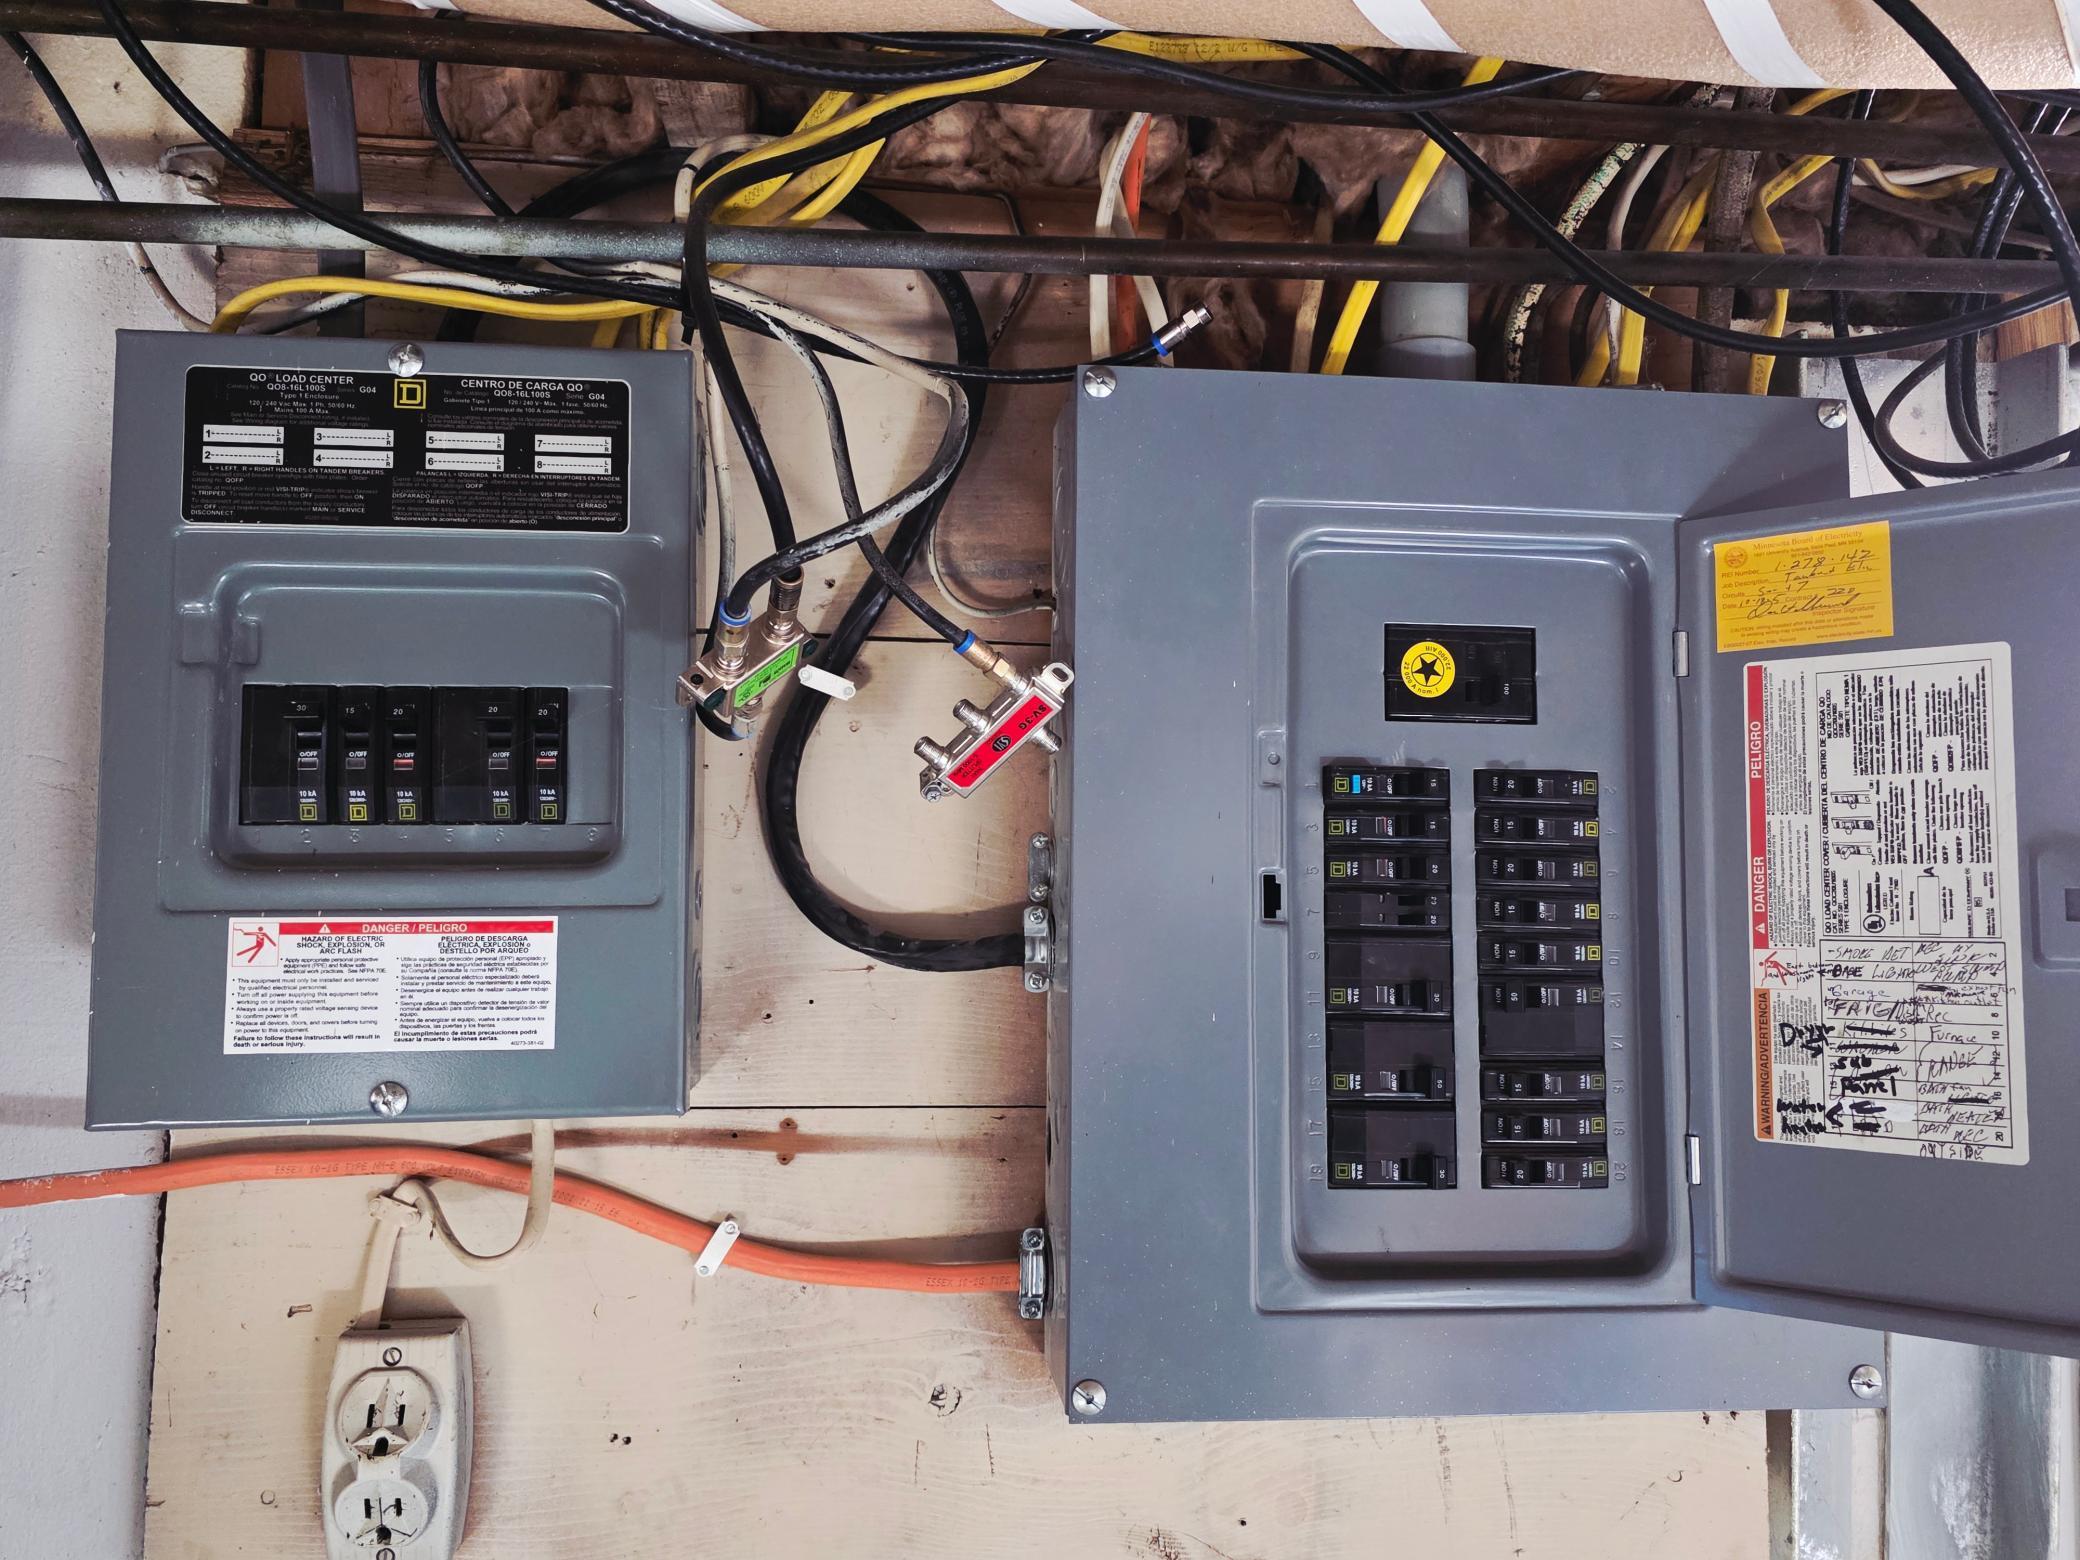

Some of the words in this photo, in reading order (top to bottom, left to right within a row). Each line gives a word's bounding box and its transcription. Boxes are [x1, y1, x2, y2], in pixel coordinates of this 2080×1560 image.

[250, 373, 266, 382] QO
[276, 374, 306, 383] LOAD
[310, 375, 354, 385] CENTER
[267, 383, 326, 392] QO8-16L100S
[360, 386, 376, 394] G04
[461, 380, 506, 389] CENTRO
[508, 381, 523, 389] DE
[526, 382, 564, 391] CARGA
[567, 383, 583, 392] QO
[589, 393, 605, 401] G04
[206, 430, 211, 438] 1
[316, 433, 323, 441] 3
[428, 436, 435, 444] 5
[537, 440, 543, 448] 7
[204, 451, 211, 459] 2
[315, 454, 322, 463] 4
[428, 457, 434, 466] 6
[537, 461, 543, 469] 8
[1753, 540, 1791, 552] Minnesota
[1792, 535, 1814, 547] Board
[1815, 534, 1823, 544] of
[1824, 530, 1863, 543] Electricity
[1735, 569, 1759, 578] Number
[1733, 578, 1769, 589] Description
[1018, 705, 1047, 730] SV-3G
[1820, 737, 1826, 748] DE
[1750, 721, 1763, 779] PELIGRO
[1753, 856, 1765, 913] DANGER
[362, 924, 410, 933] DANGER
[419, 924, 467, 932] PELIGRO
[1755, 992, 1771, 1126] WARNING/ADVERTENCIA
